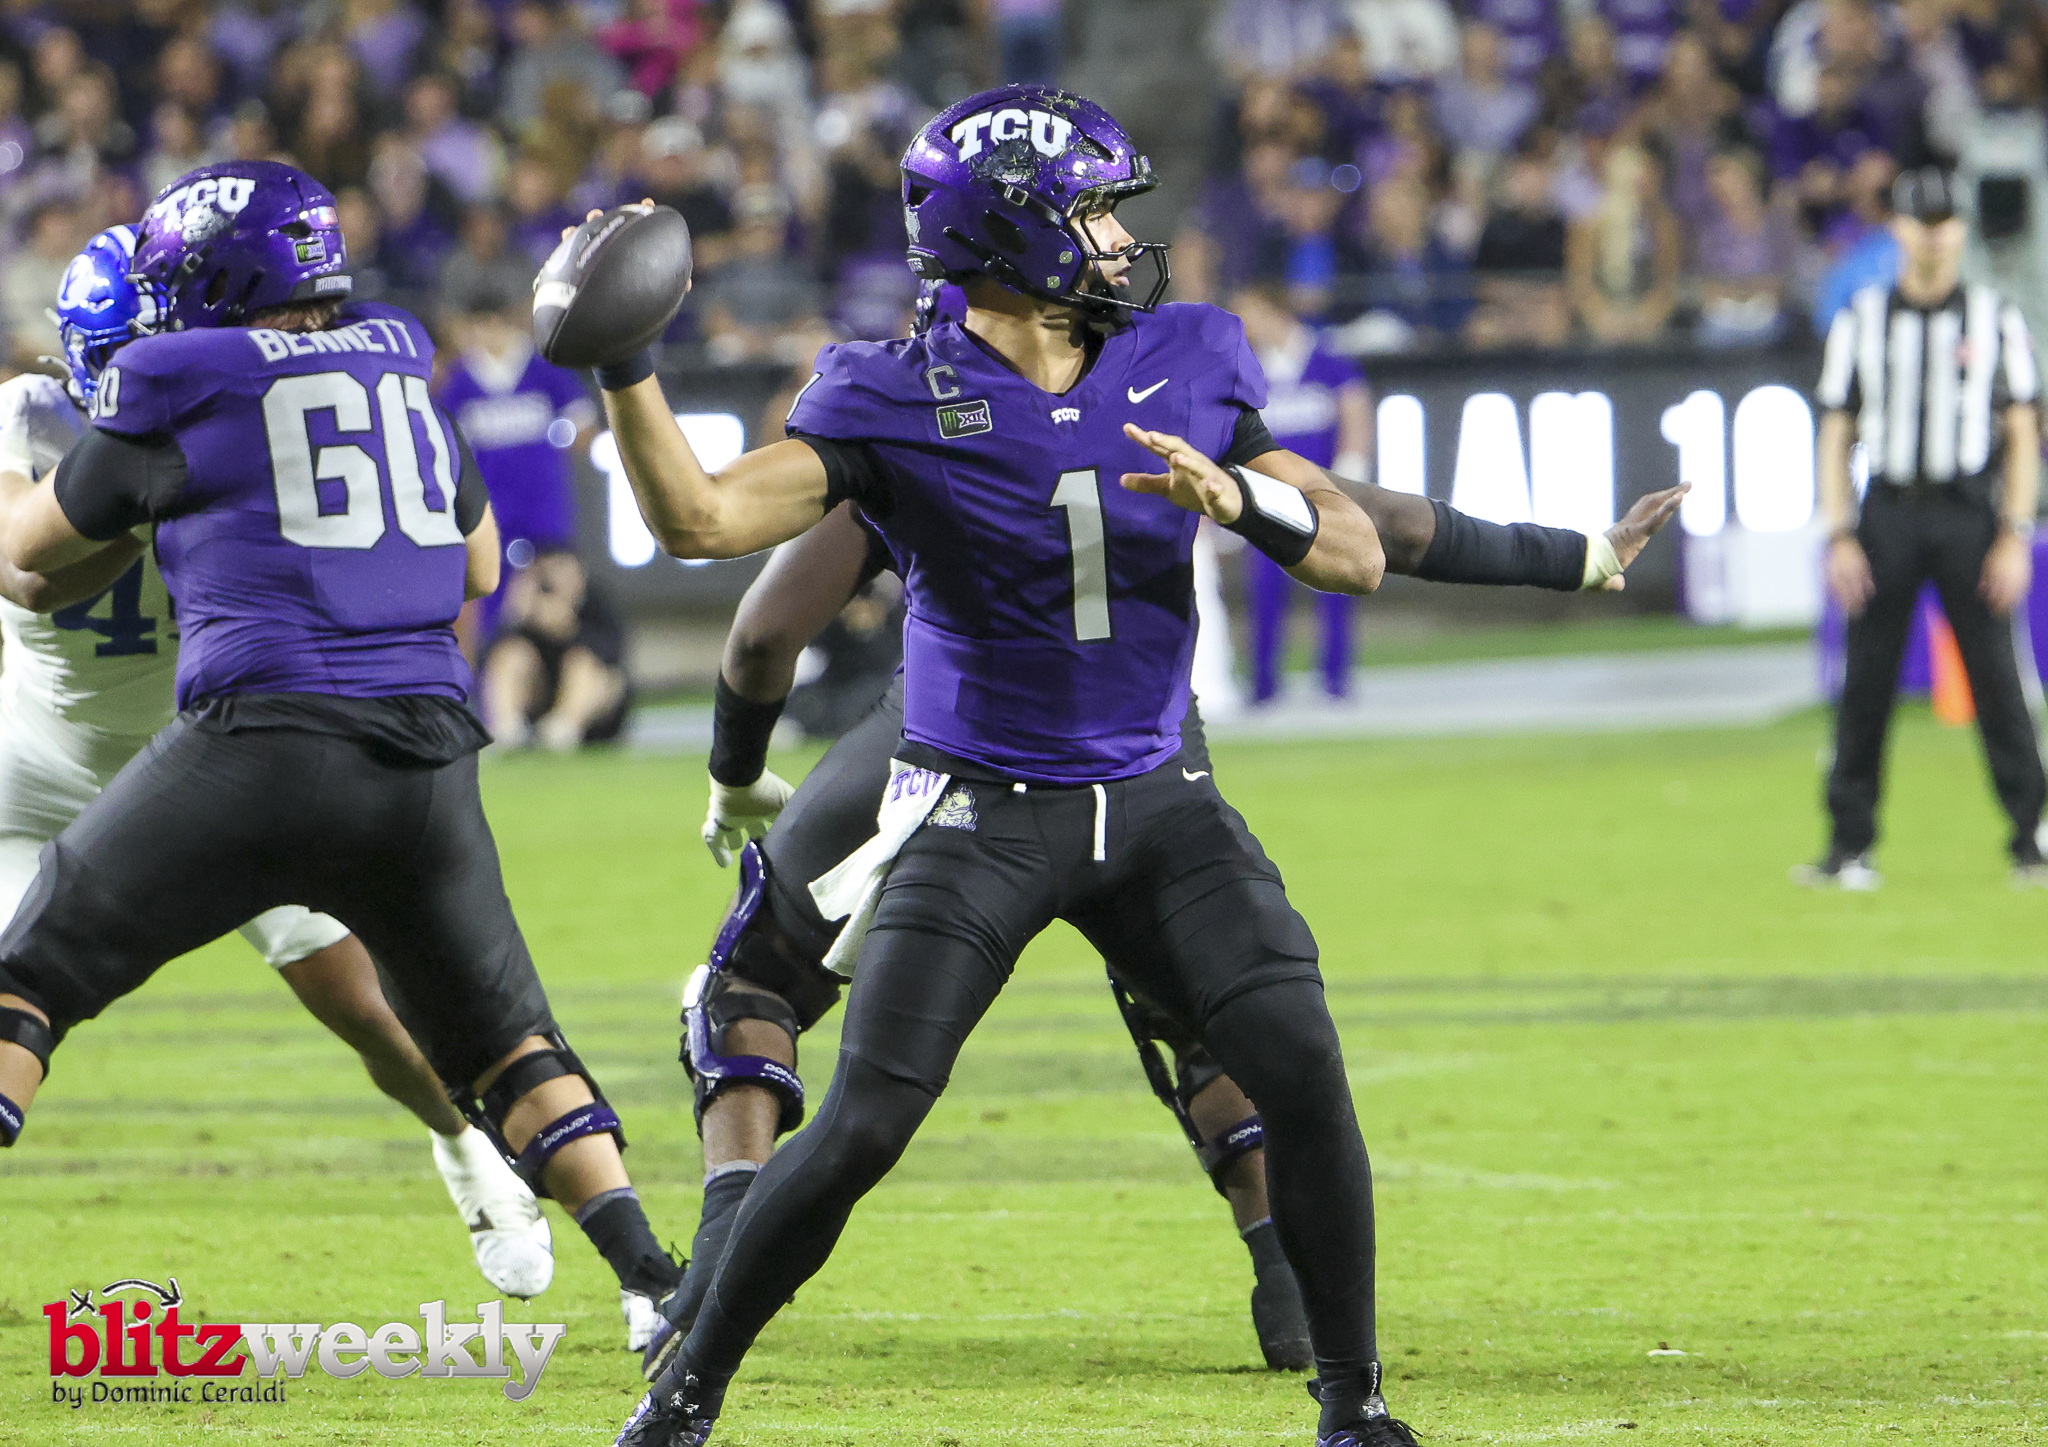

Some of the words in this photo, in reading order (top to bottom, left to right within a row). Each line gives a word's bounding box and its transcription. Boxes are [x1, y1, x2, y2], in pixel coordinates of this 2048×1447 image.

[951, 108, 1072, 163] TCU
[152, 177, 256, 233] TCU
[248, 318, 418, 363] BENNETT
[926, 364, 962, 400] C
[1051, 407, 1081, 424] TCU
[262, 370, 467, 551] 60
[1661, 385, 1815, 536] 10
[1050, 468, 1112, 643] 1
[52, 553, 180, 658] 4
